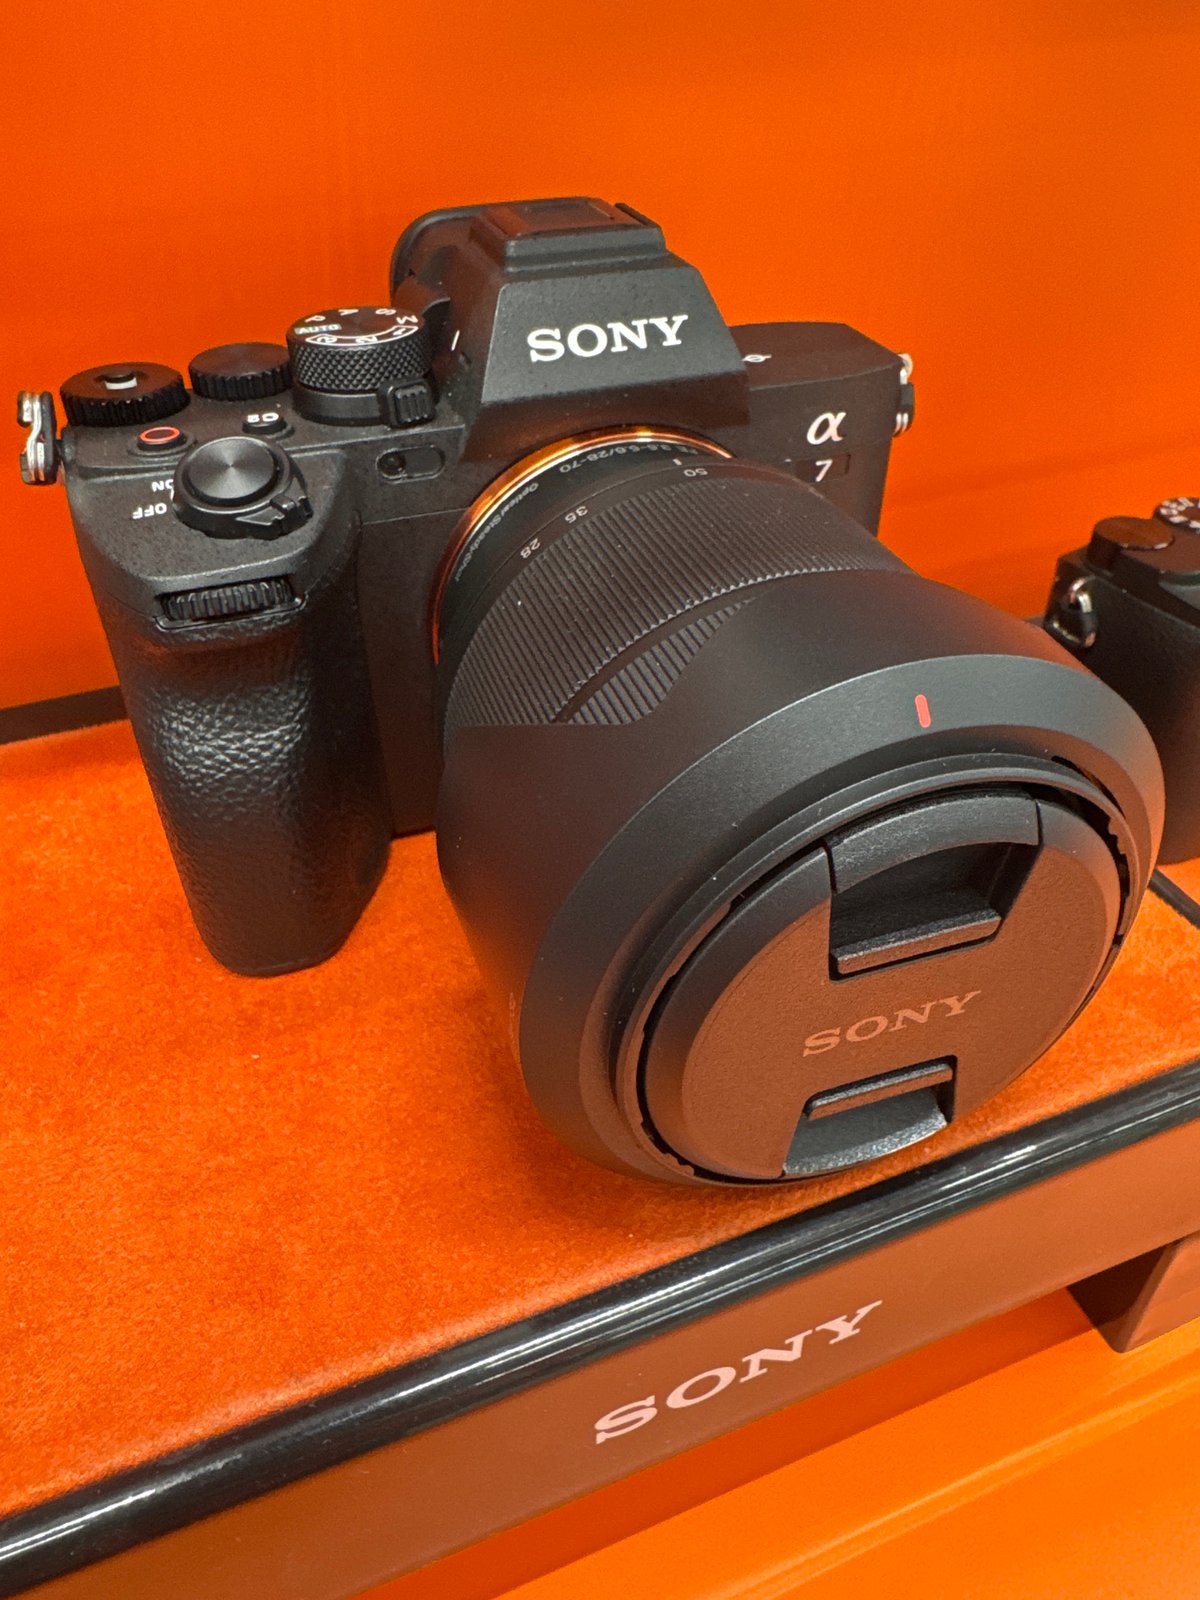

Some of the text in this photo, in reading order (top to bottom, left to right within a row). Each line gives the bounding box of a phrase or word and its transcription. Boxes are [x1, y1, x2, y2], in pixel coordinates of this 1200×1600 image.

[299, 324, 340, 334] AUTO
[527, 314, 689, 363] SONY
[683, 467, 708, 478] 50
[815, 459, 833, 482] 7
[132, 503, 167, 520] OFF
[564, 505, 588, 524] 35
[520, 537, 541, 559] 28
[803, 990, 981, 1057] SONY
[594, 1300, 883, 1445] SONY
